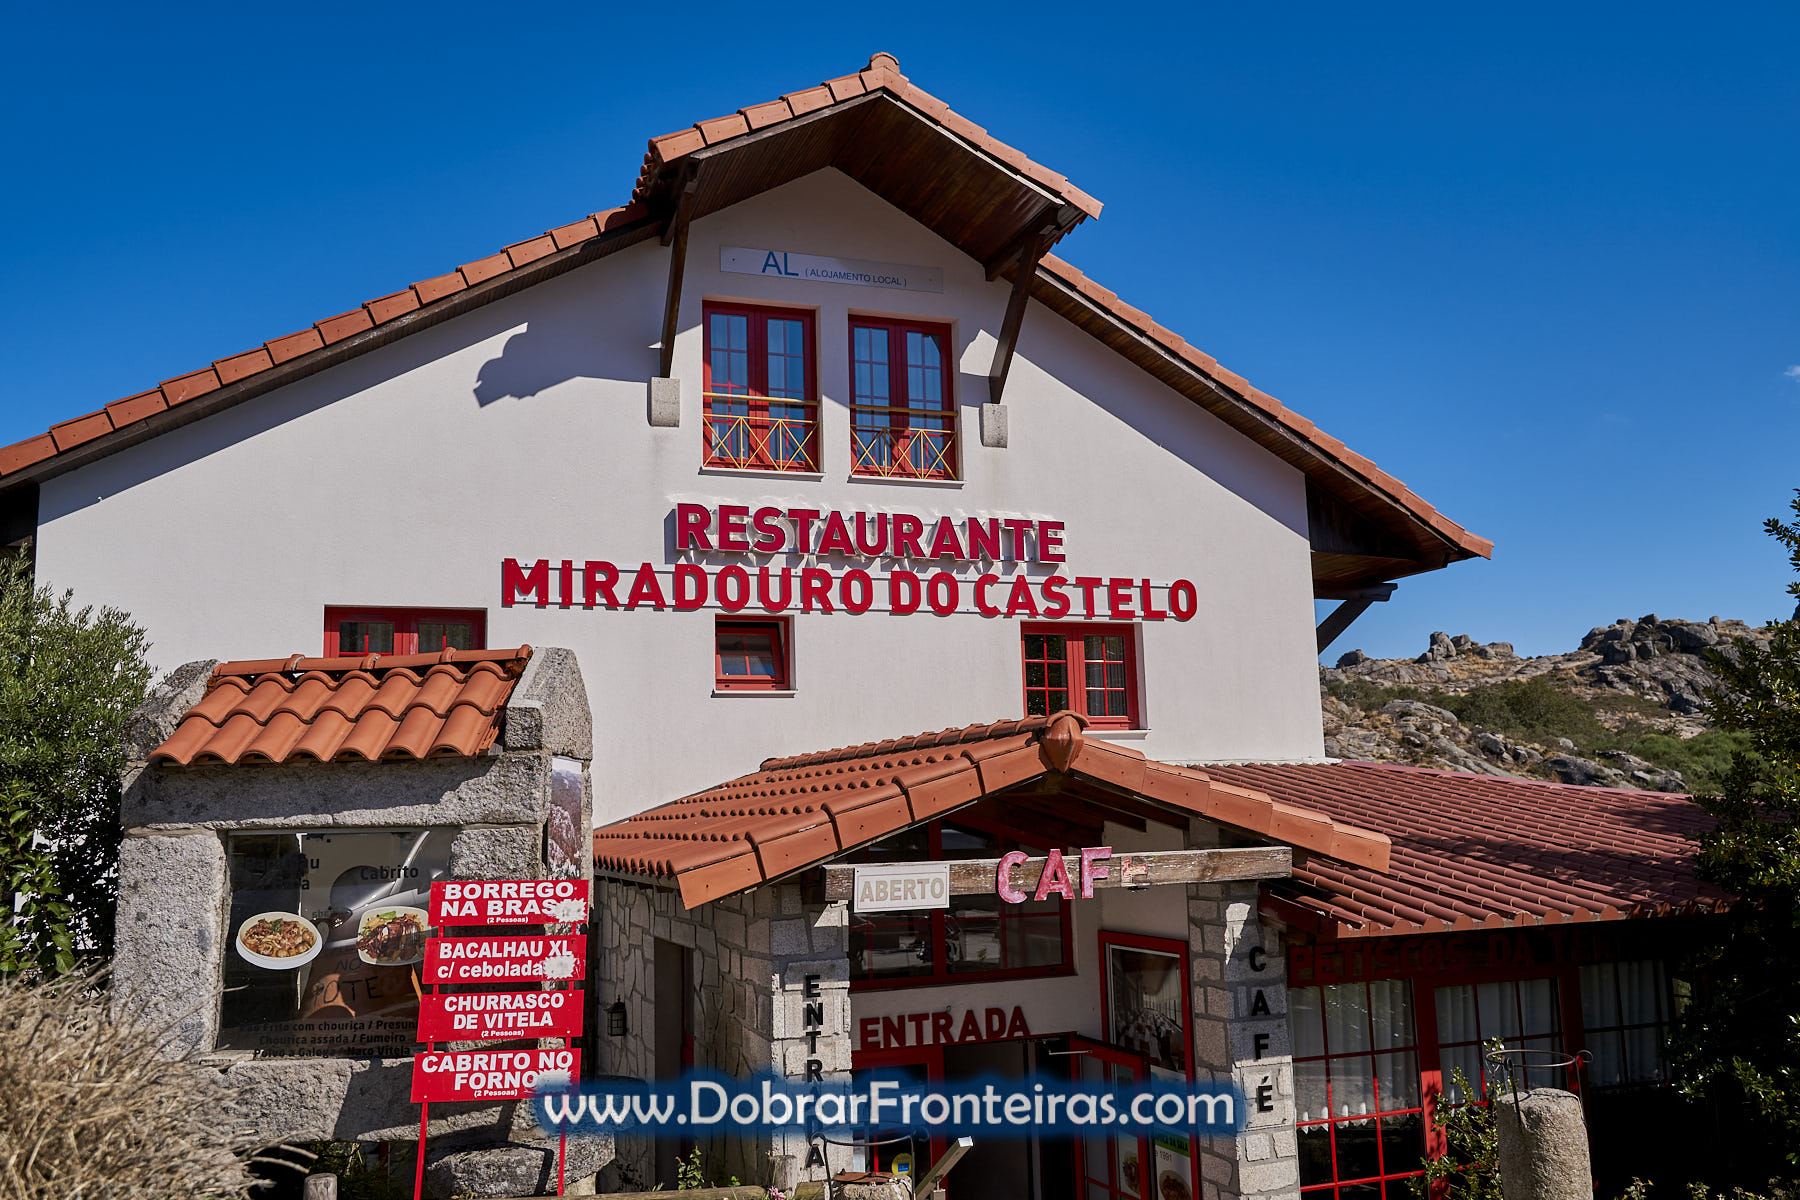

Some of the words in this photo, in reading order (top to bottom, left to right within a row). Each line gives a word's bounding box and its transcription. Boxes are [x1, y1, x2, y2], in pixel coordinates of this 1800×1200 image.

[762, 251, 799, 276] AL
[676, 502, 1066, 562] RESTAURANTE
[503, 557, 874, 613] MIRADOURO
[890, 570, 959, 616] DO
[975, 573, 1198, 621] CASTELO
[360, 865, 419, 881] Cabrito
[444, 882, 574, 900] BORREGO
[859, 877, 945, 903] ABERTO
[441, 900, 479, 917] NA
[487, 899, 572, 916] BRAS
[486, 916, 495, 924] (2
[496, 916, 529, 924] Pessoas)
[439, 940, 544, 959] BACALHAU
[437, 961, 455, 979] c/
[459, 959, 543, 978] cebolada
[444, 993, 565, 1012] CHURRASCO
[293, 1023, 315, 1032] com
[318, 1020, 365, 1033] chouriça
[375, 1020, 417, 1031] Presun
[453, 1013, 479, 1030] DE
[484, 1012, 554, 1029] VITELA
[858, 1005, 1032, 1051] ENTRADA
[1249, 946, 1274, 1112] CAFÉ
[310, 1034, 349, 1044] assada
[360, 1032, 406, 1044] Fumeiro
[480, 1029, 489, 1038] (2
[490, 1029, 525, 1037] Pessoas)
[422, 1052, 531, 1073] CABRITO
[538, 1051, 574, 1070] NO
[454, 1070, 540, 1091] FORNO
[473, 1089, 482, 1098] (2
[483, 1088, 518, 1097] Pessoas)
